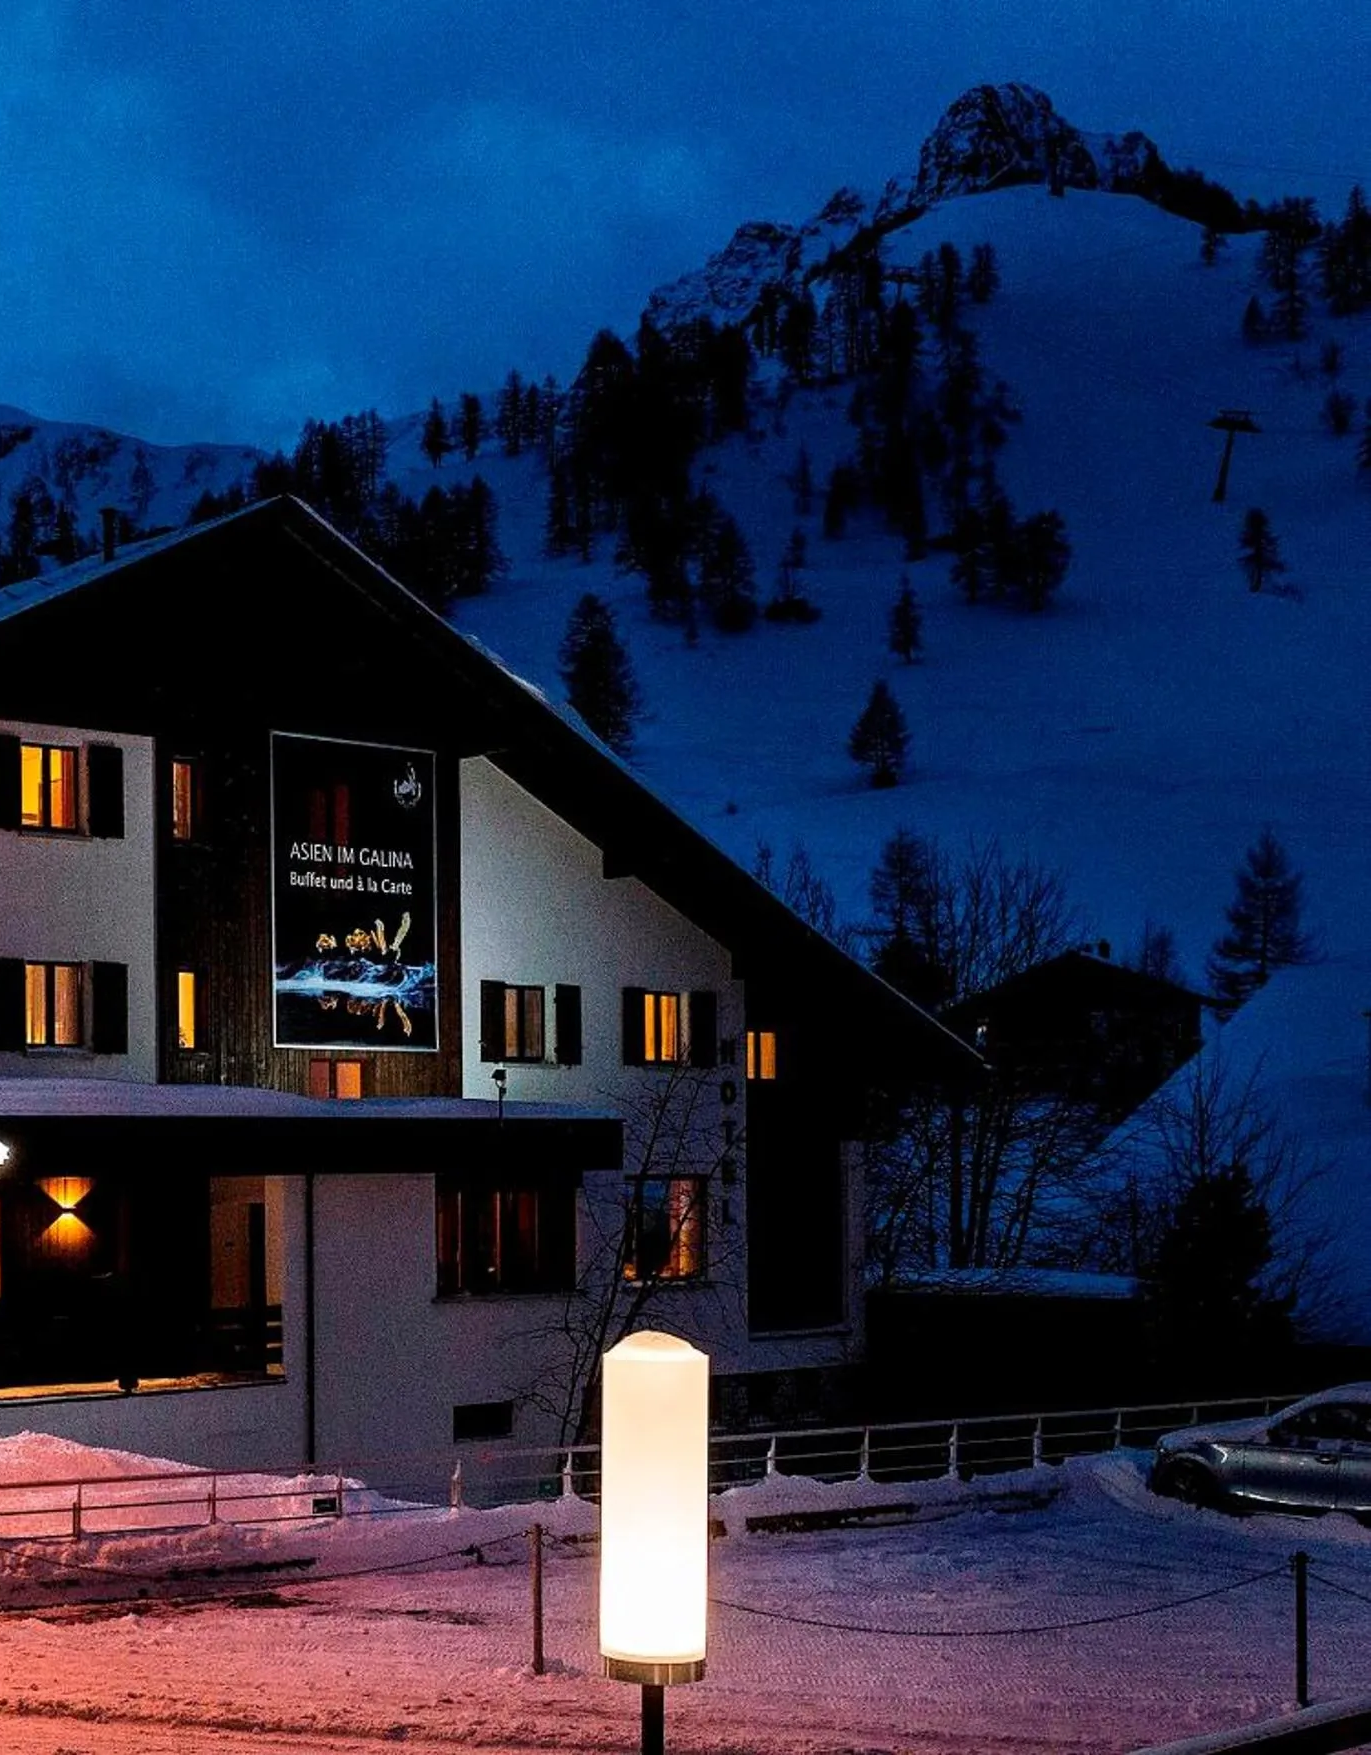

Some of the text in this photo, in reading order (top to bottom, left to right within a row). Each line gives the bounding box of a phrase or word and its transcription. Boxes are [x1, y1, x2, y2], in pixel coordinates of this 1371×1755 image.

[290, 842, 414, 869] ASIEN IM GALINA
[290, 872, 327, 889] Buffet
[330, 876, 354, 890] und
[367, 877, 378, 893] la
[381, 879, 413, 895] Carte
